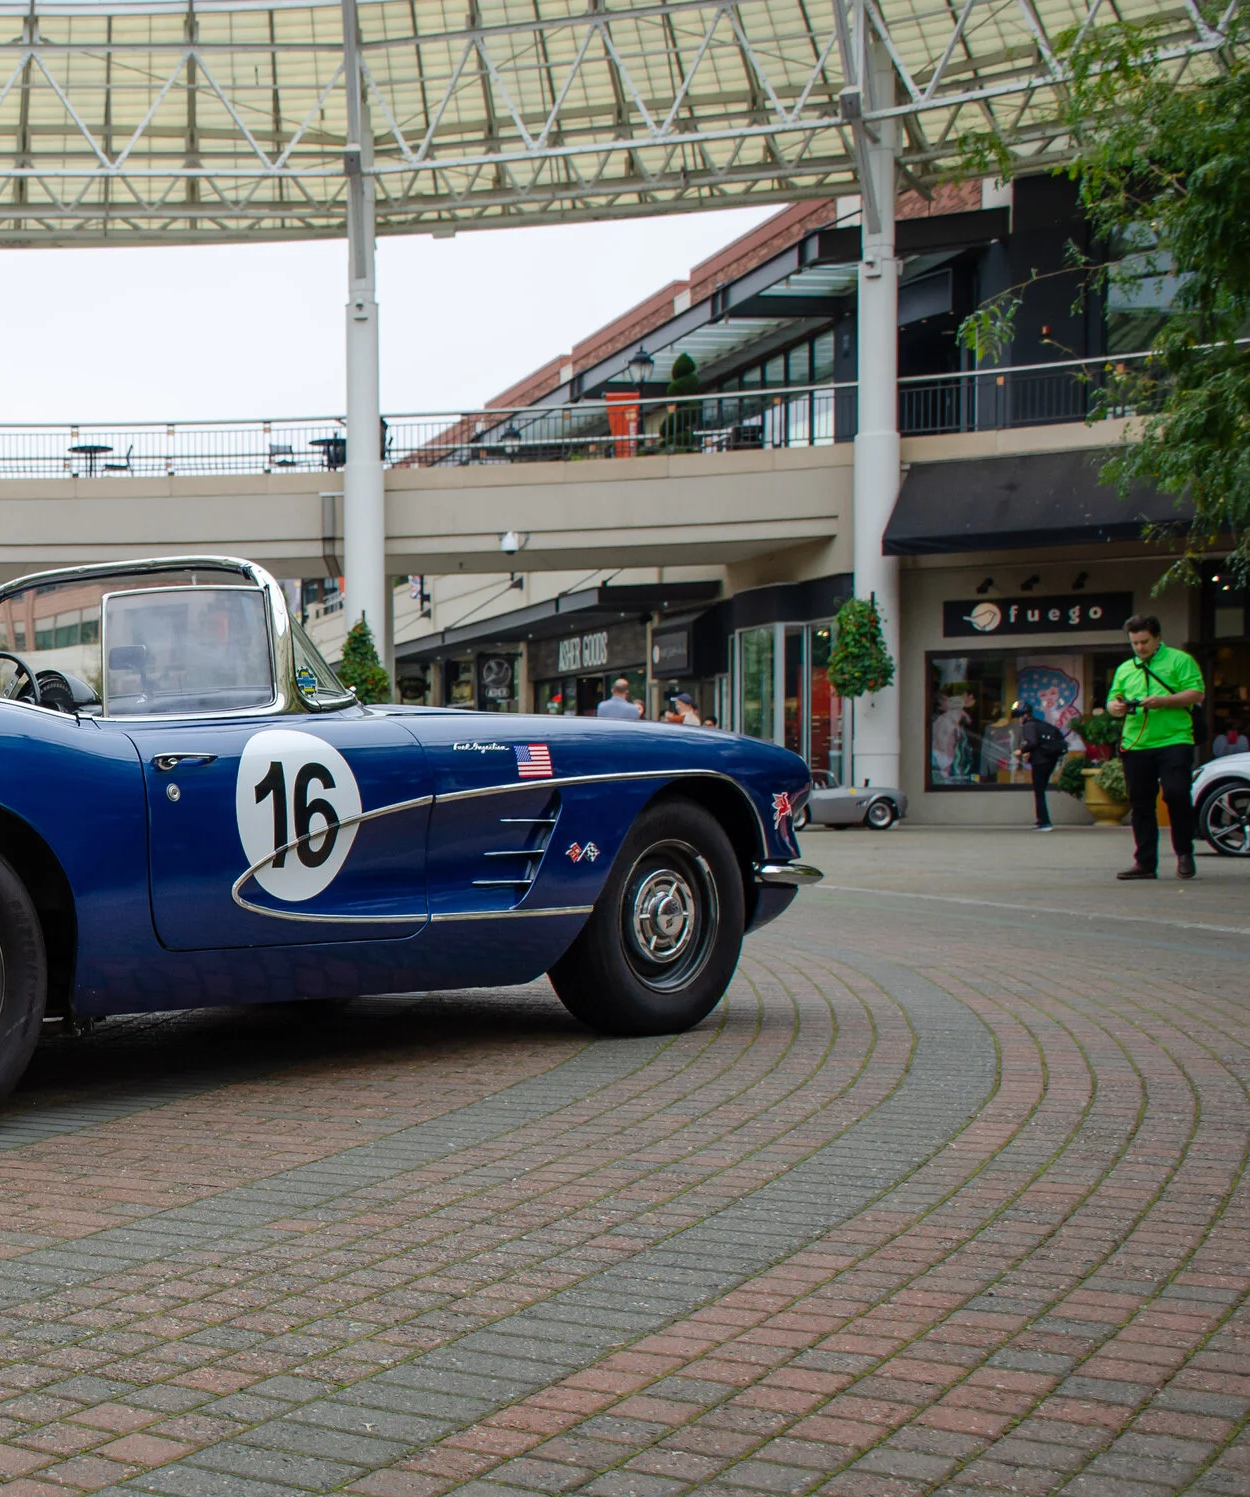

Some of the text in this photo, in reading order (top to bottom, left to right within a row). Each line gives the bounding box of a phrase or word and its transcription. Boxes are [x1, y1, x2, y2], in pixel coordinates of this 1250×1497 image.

[1008, 604, 1103, 625] fuego
[558, 631, 608, 673] ASHER GOODS
[254, 761, 341, 868] 16
